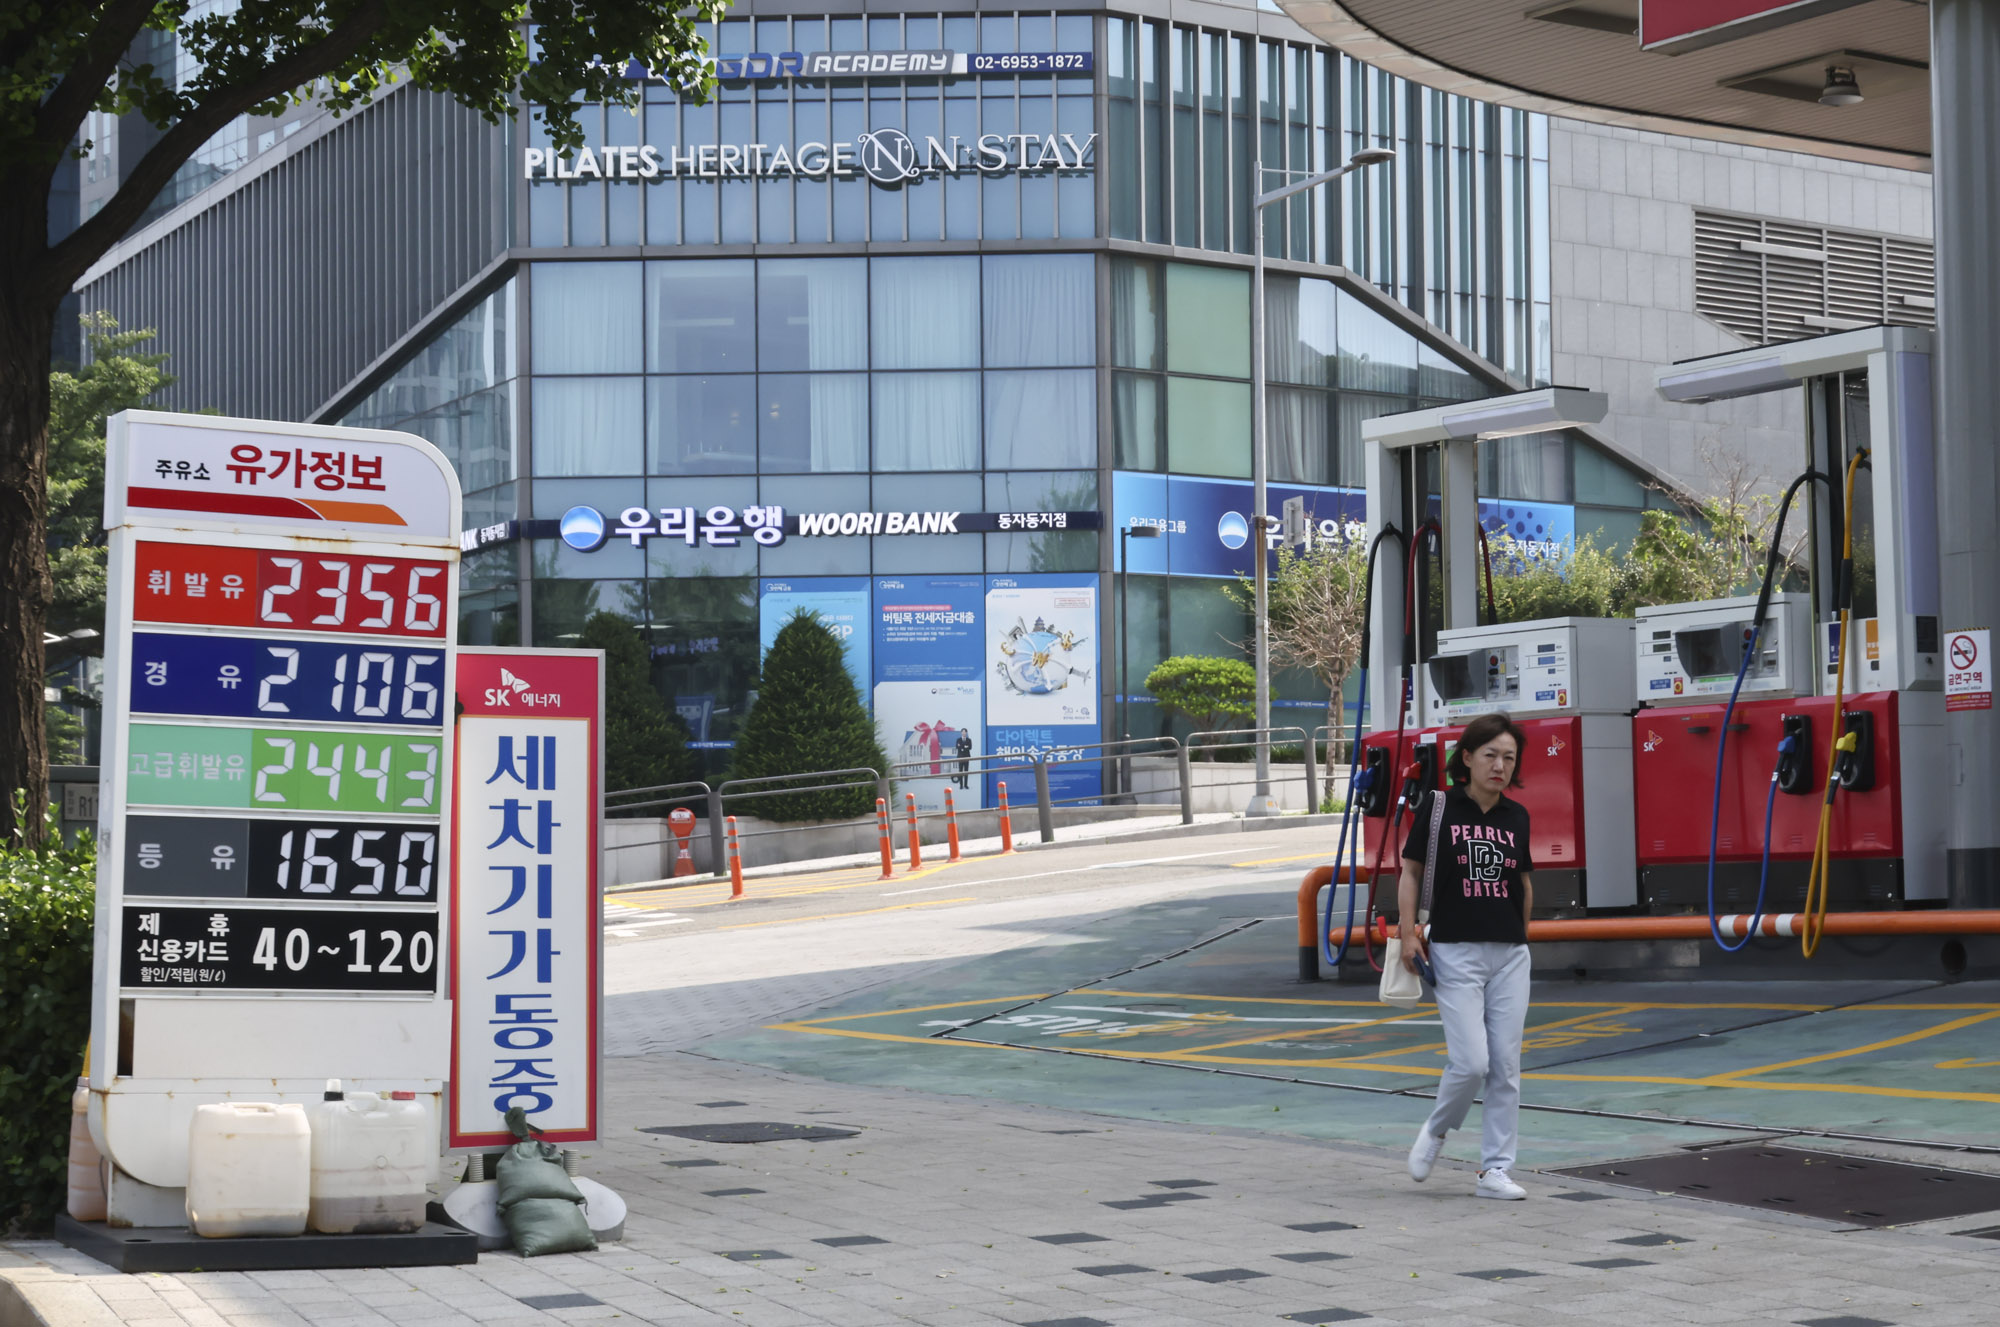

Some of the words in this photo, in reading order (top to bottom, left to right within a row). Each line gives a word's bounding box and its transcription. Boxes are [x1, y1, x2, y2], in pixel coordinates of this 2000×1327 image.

[716, 52, 804, 79] GDR
[813, 54, 948, 74] ACADEMY
[974, 54, 1084, 70] 02-6953-1872
[524, 144, 659, 179] PILATES
[671, 142, 852, 177] HERITAGE
[976, 133, 1099, 171] STAY
[155, 458, 211, 481] 주유소
[225, 443, 387, 492] 유가정보
[614, 505, 785, 547] 우리은행
[798, 512, 881, 536] WOORI
[884, 510, 961, 534] BANK
[997, 512, 1068, 529] 동자동지점
[1506, 539, 1561, 558] 동자동지점
[260, 556, 442, 632] 2356
[915, 611, 975, 624] 전세자금대출
[257, 646, 440, 719] 2106
[1948, 671, 1983, 686] 금연구역
[484, 688, 510, 706] SK
[521, 692, 560, 707] 에너지
[996, 728, 1053, 745] 다이렉트
[1643, 741, 1655, 752] SK
[1547, 746, 1558, 756] SK
[128, 751, 247, 784] 고급휘발유
[254, 736, 440, 808] 2443
[1450, 824, 1515, 848] PEARLY
[276, 827, 437, 896] 1650
[1457, 855, 1468, 864] 19
[1504, 858, 1517, 869] 89
[1462, 877, 1508, 898] GATES
[137, 938, 229, 963] 신용카드
[252, 925, 435, 975] 40~120
